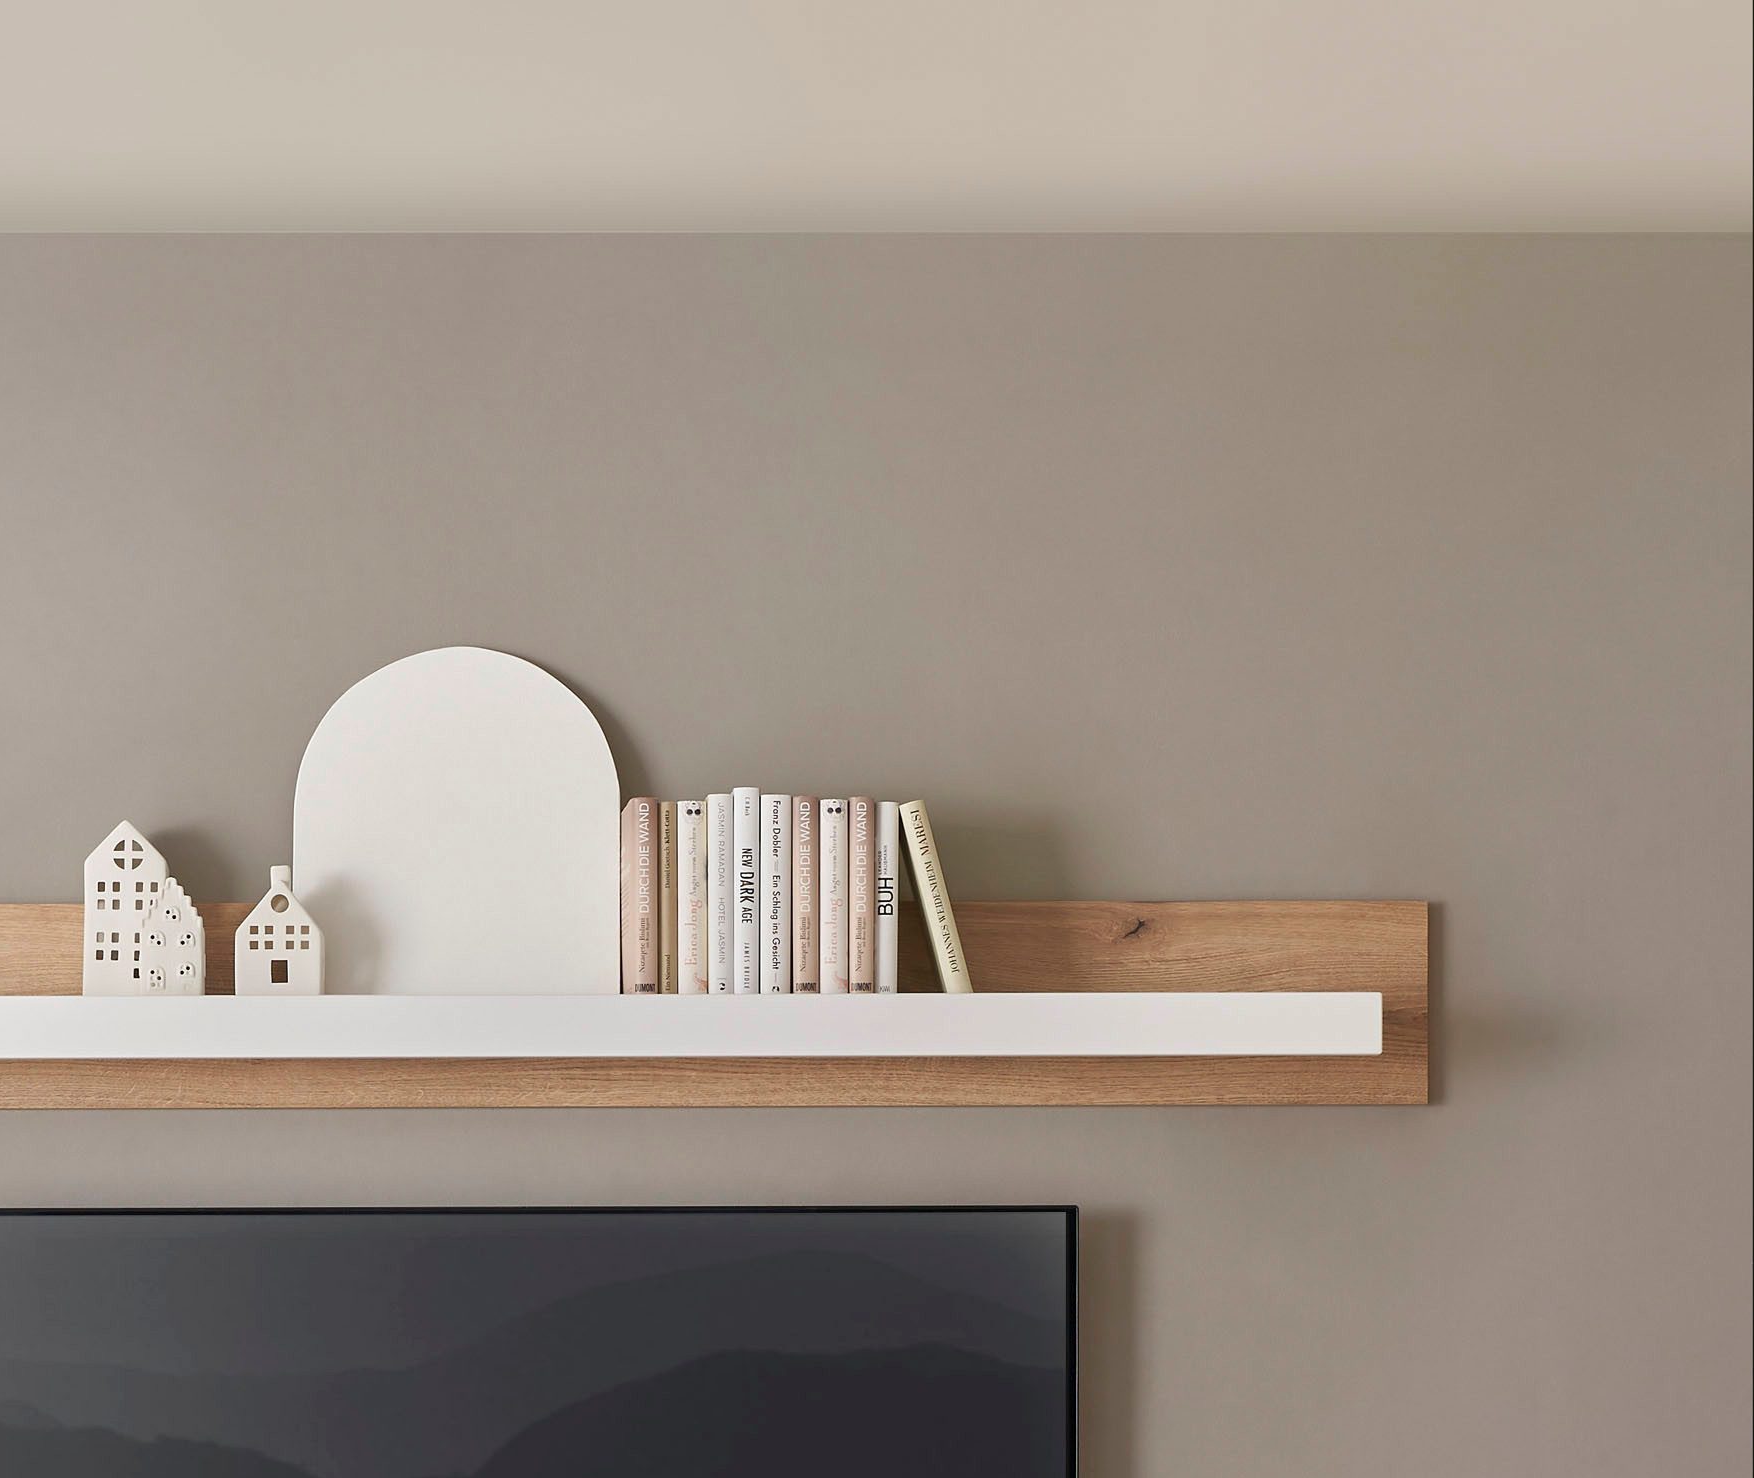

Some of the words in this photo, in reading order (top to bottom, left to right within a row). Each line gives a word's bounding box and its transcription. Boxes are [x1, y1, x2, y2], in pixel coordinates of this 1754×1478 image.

[639, 803, 650, 843] WAND
[772, 800, 781, 825] Franz
[800, 802, 810, 842] WAND
[856, 802, 867, 842] WAND
[772, 828, 781, 858] Dobler
[910, 809, 930, 856] MARESI
[639, 845, 650, 866] DIE
[741, 848, 753, 868] NEW
[800, 844, 810, 865] DIE
[856, 844, 867, 865] DIE
[639, 868, 650, 913] DURCH
[739, 872, 755, 904] DARK
[772, 875, 781, 888] Ein
[800, 867, 810, 912] DURCH
[856, 867, 867, 912] DURCH
[878, 877, 894, 916] BUH
[924, 860, 946, 923] WEIDENHEIM
[684, 899, 703, 930] Jong
[741, 907, 753, 924] AGE
[769, 890, 781, 920] Schlag
[824, 898, 843, 929] Jong
[772, 922, 781, 935] ins
[684, 934, 698, 965] Erica
[718, 929, 726, 964] JASMIN
[772, 937, 781, 970] Gesicht
[825, 931, 838, 964] Erica
[941, 924, 960, 973] JOHANNES
[635, 983, 656, 992] DUMONT
[795, 982, 817, 992] DUMONT
[851, 982, 872, 992] DUMONT
